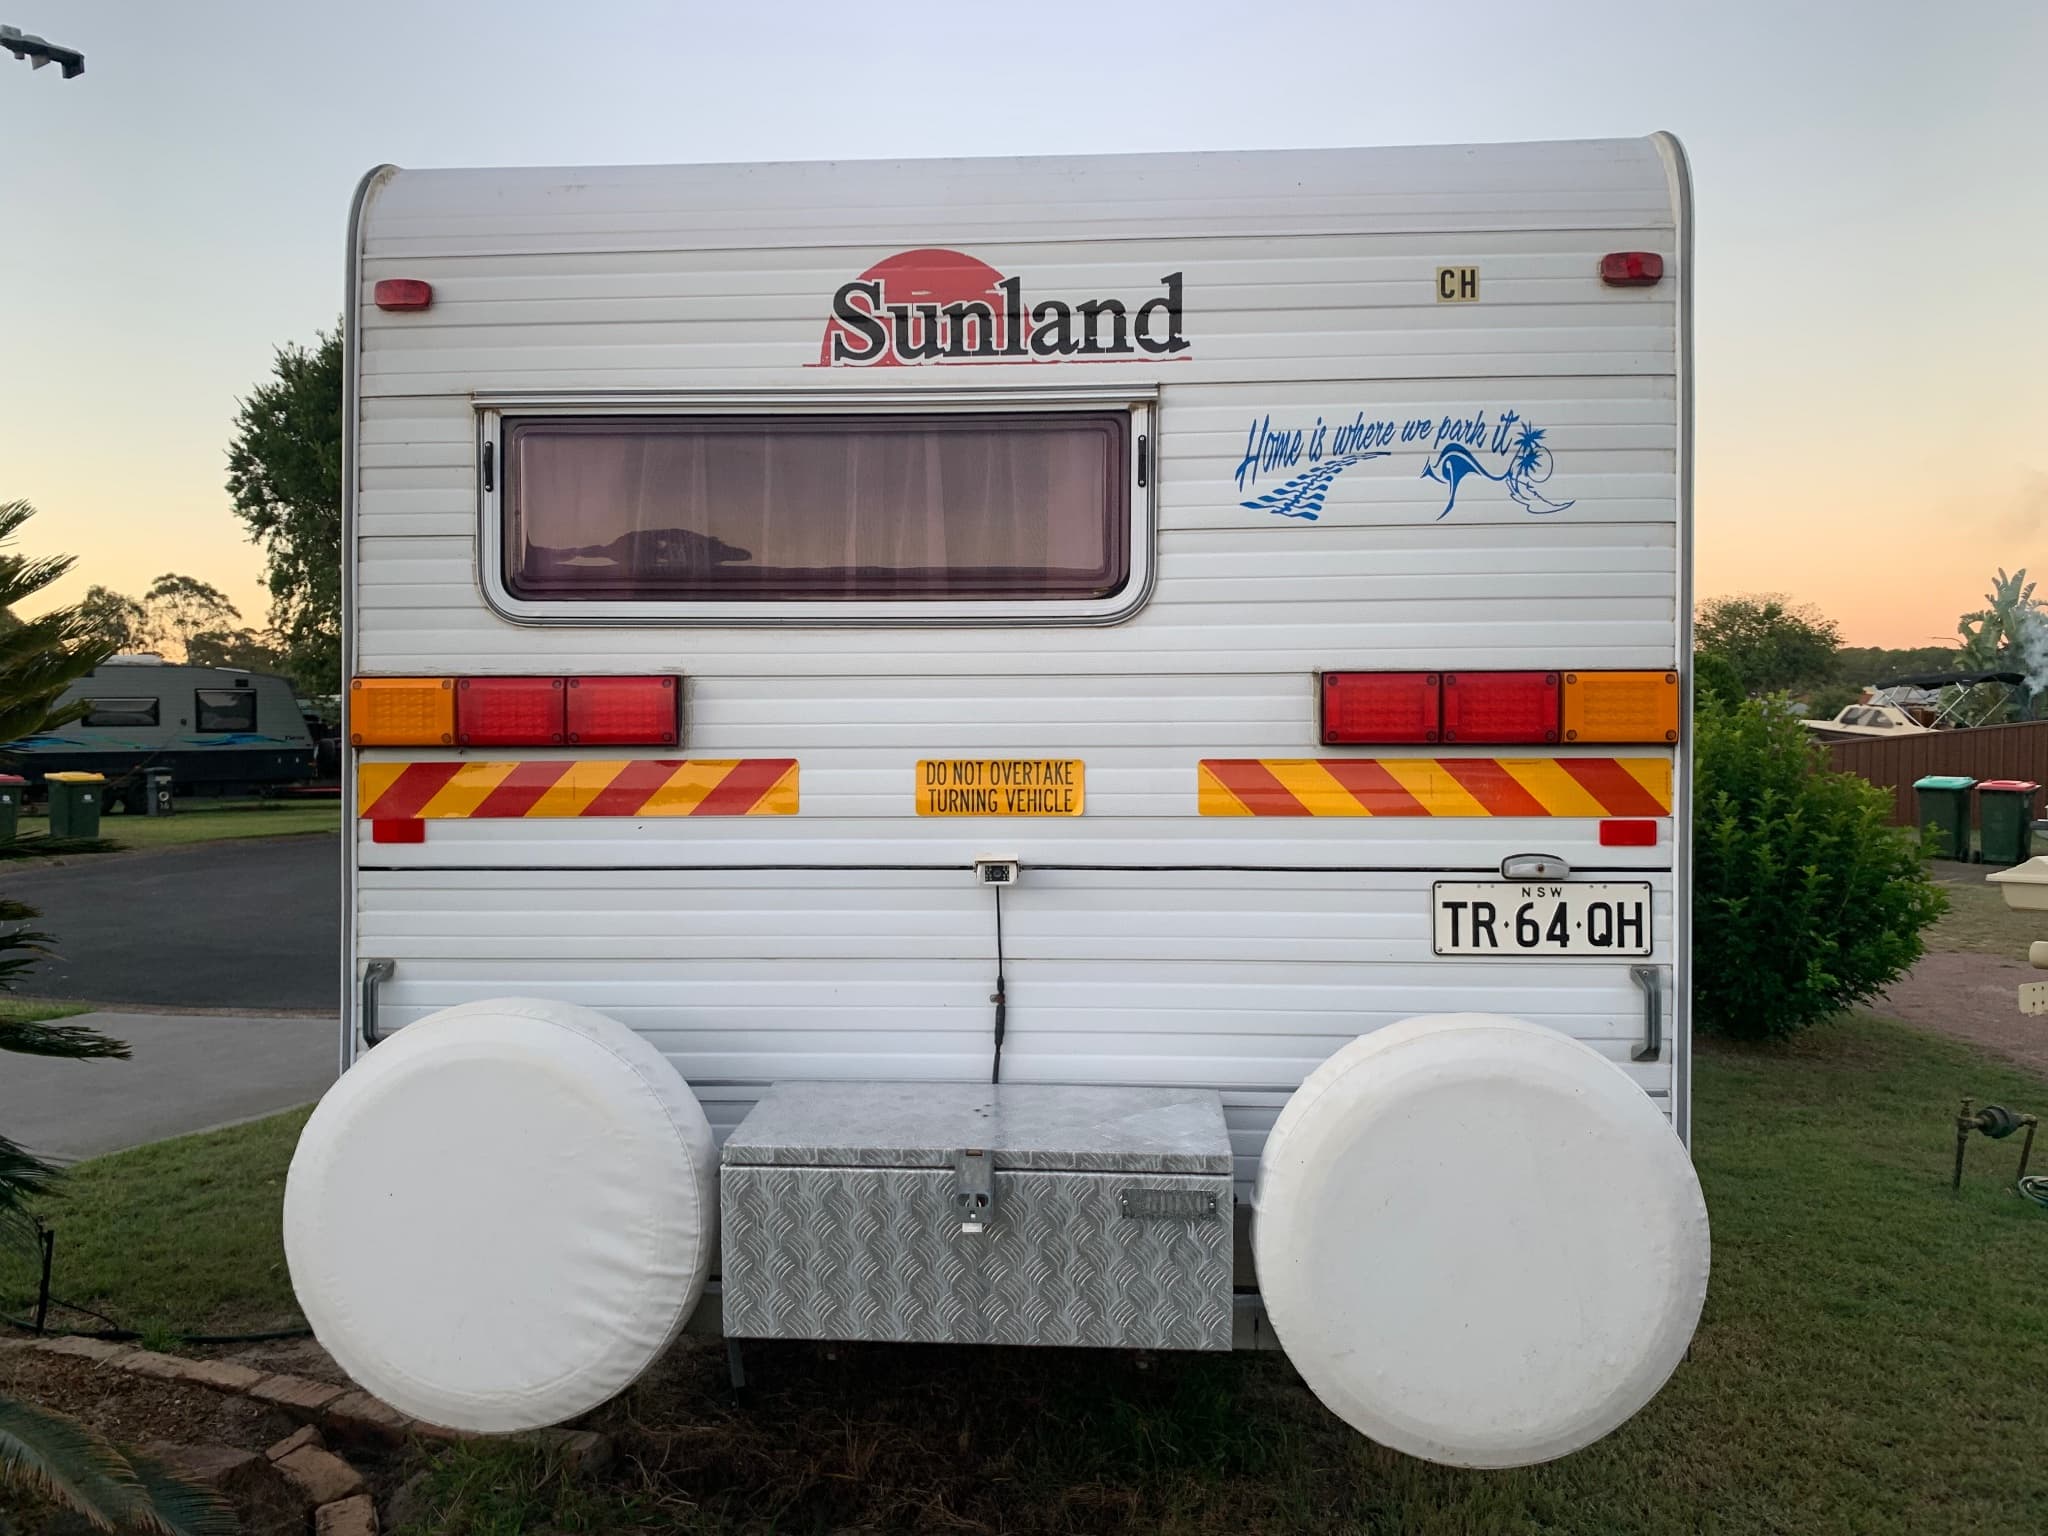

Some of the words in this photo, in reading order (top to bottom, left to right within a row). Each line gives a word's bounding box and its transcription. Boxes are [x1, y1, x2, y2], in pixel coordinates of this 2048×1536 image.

[1439, 269, 1477, 299] CH
[832, 271, 1192, 362] Sunland
[1234, 412, 1304, 493] Home
[1308, 415, 1327, 463] is
[1332, 410, 1397, 456] where
[1400, 418, 1434, 442] we
[1432, 409, 1488, 450] park
[1491, 408, 1520, 456] it
[925, 760, 948, 786] DO
[952, 760, 985, 786] NOT
[989, 760, 1074, 786] OVERTAKE
[927, 788, 998, 813] TURNING
[1005, 788, 1073, 813] VEHICLE
[1521, 886, 1563, 898] NSW
